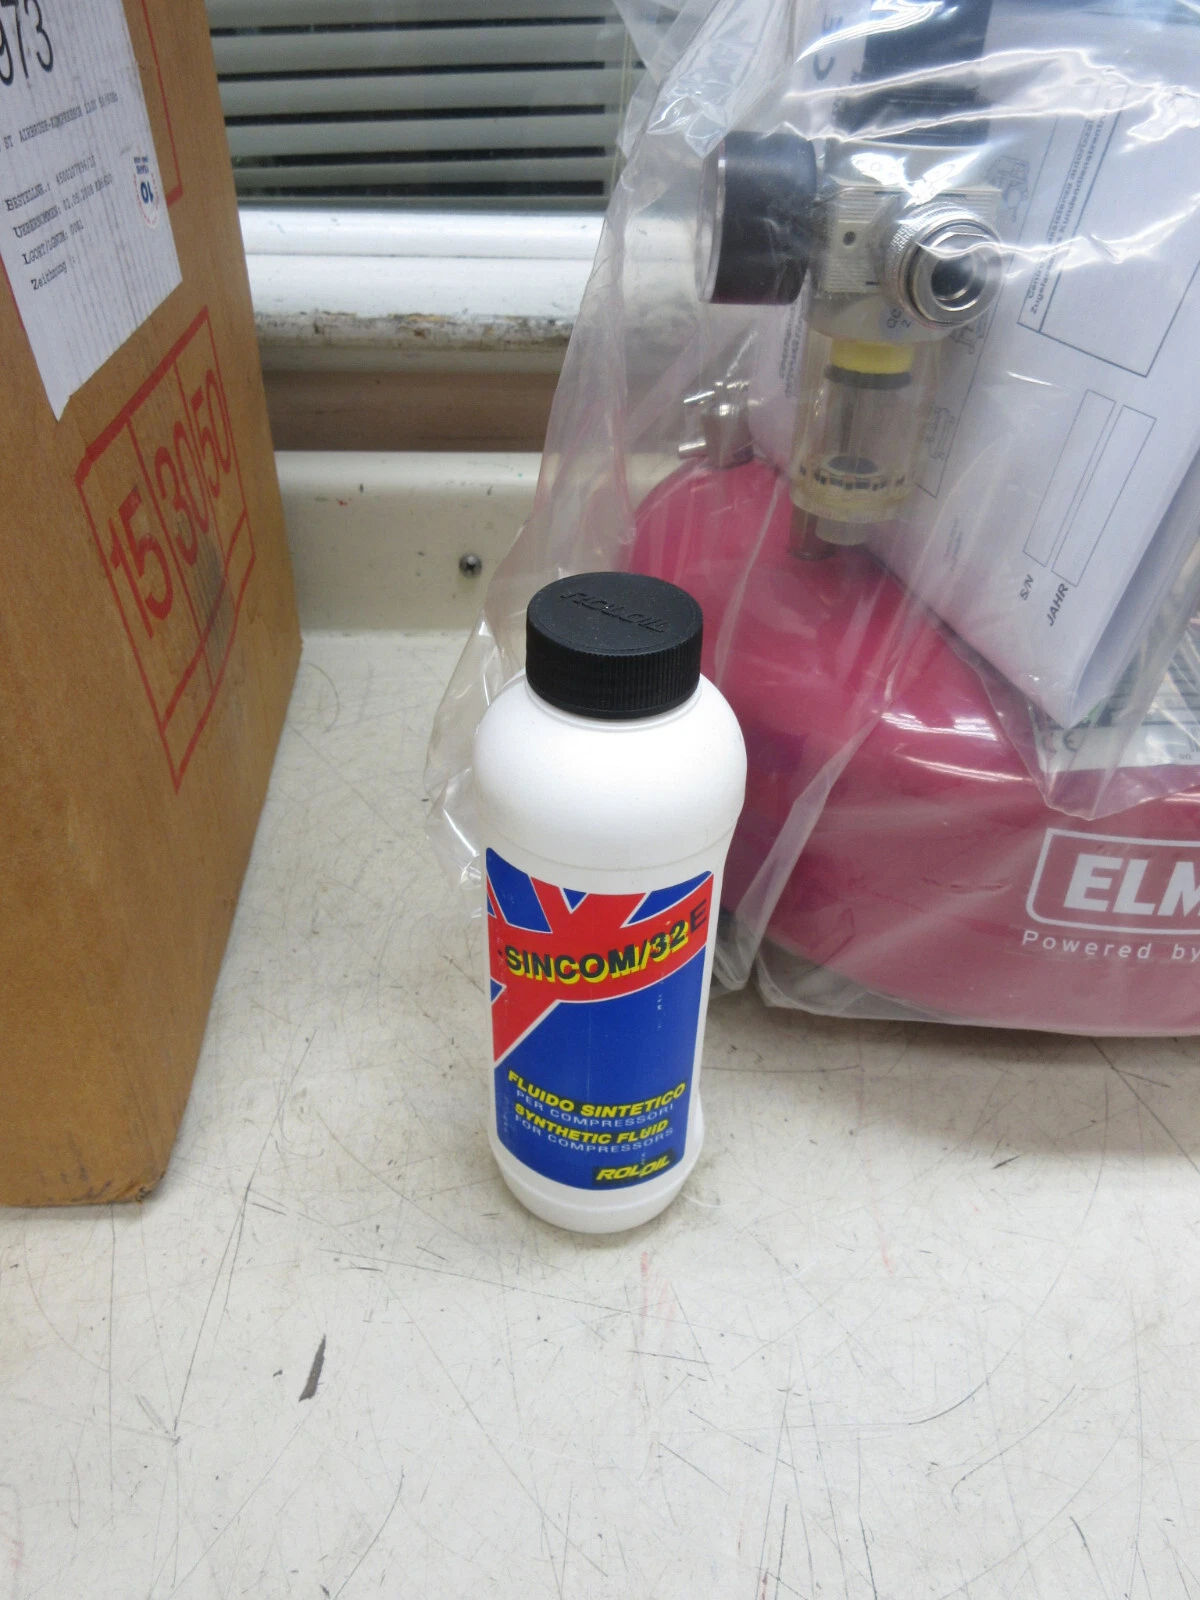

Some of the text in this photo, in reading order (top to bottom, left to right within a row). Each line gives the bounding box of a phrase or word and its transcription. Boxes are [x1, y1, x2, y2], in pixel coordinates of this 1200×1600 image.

[141, 181, 154, 204] 10
[31, 261, 67, 290] Zeichnung
[109, 369, 231, 640] 15 30 50
[1020, 574, 1034, 600] S/N
[1047, 583, 1069, 626] JAHR
[1022, 930, 1200, 962] Powered by
[508, 1070, 686, 1118] FLUIDO SINTETICO
[516, 1090, 673, 1128] PER COMPRESSORI
[515, 1103, 612, 1144] SYNTHETIC
[616, 1119, 669, 1144] FLUID
[515, 1114, 541, 1136] FOR
[548, 1127, 673, 1153] COMPRESSORS
[596, 1155, 671, 1181] ROLOIL
